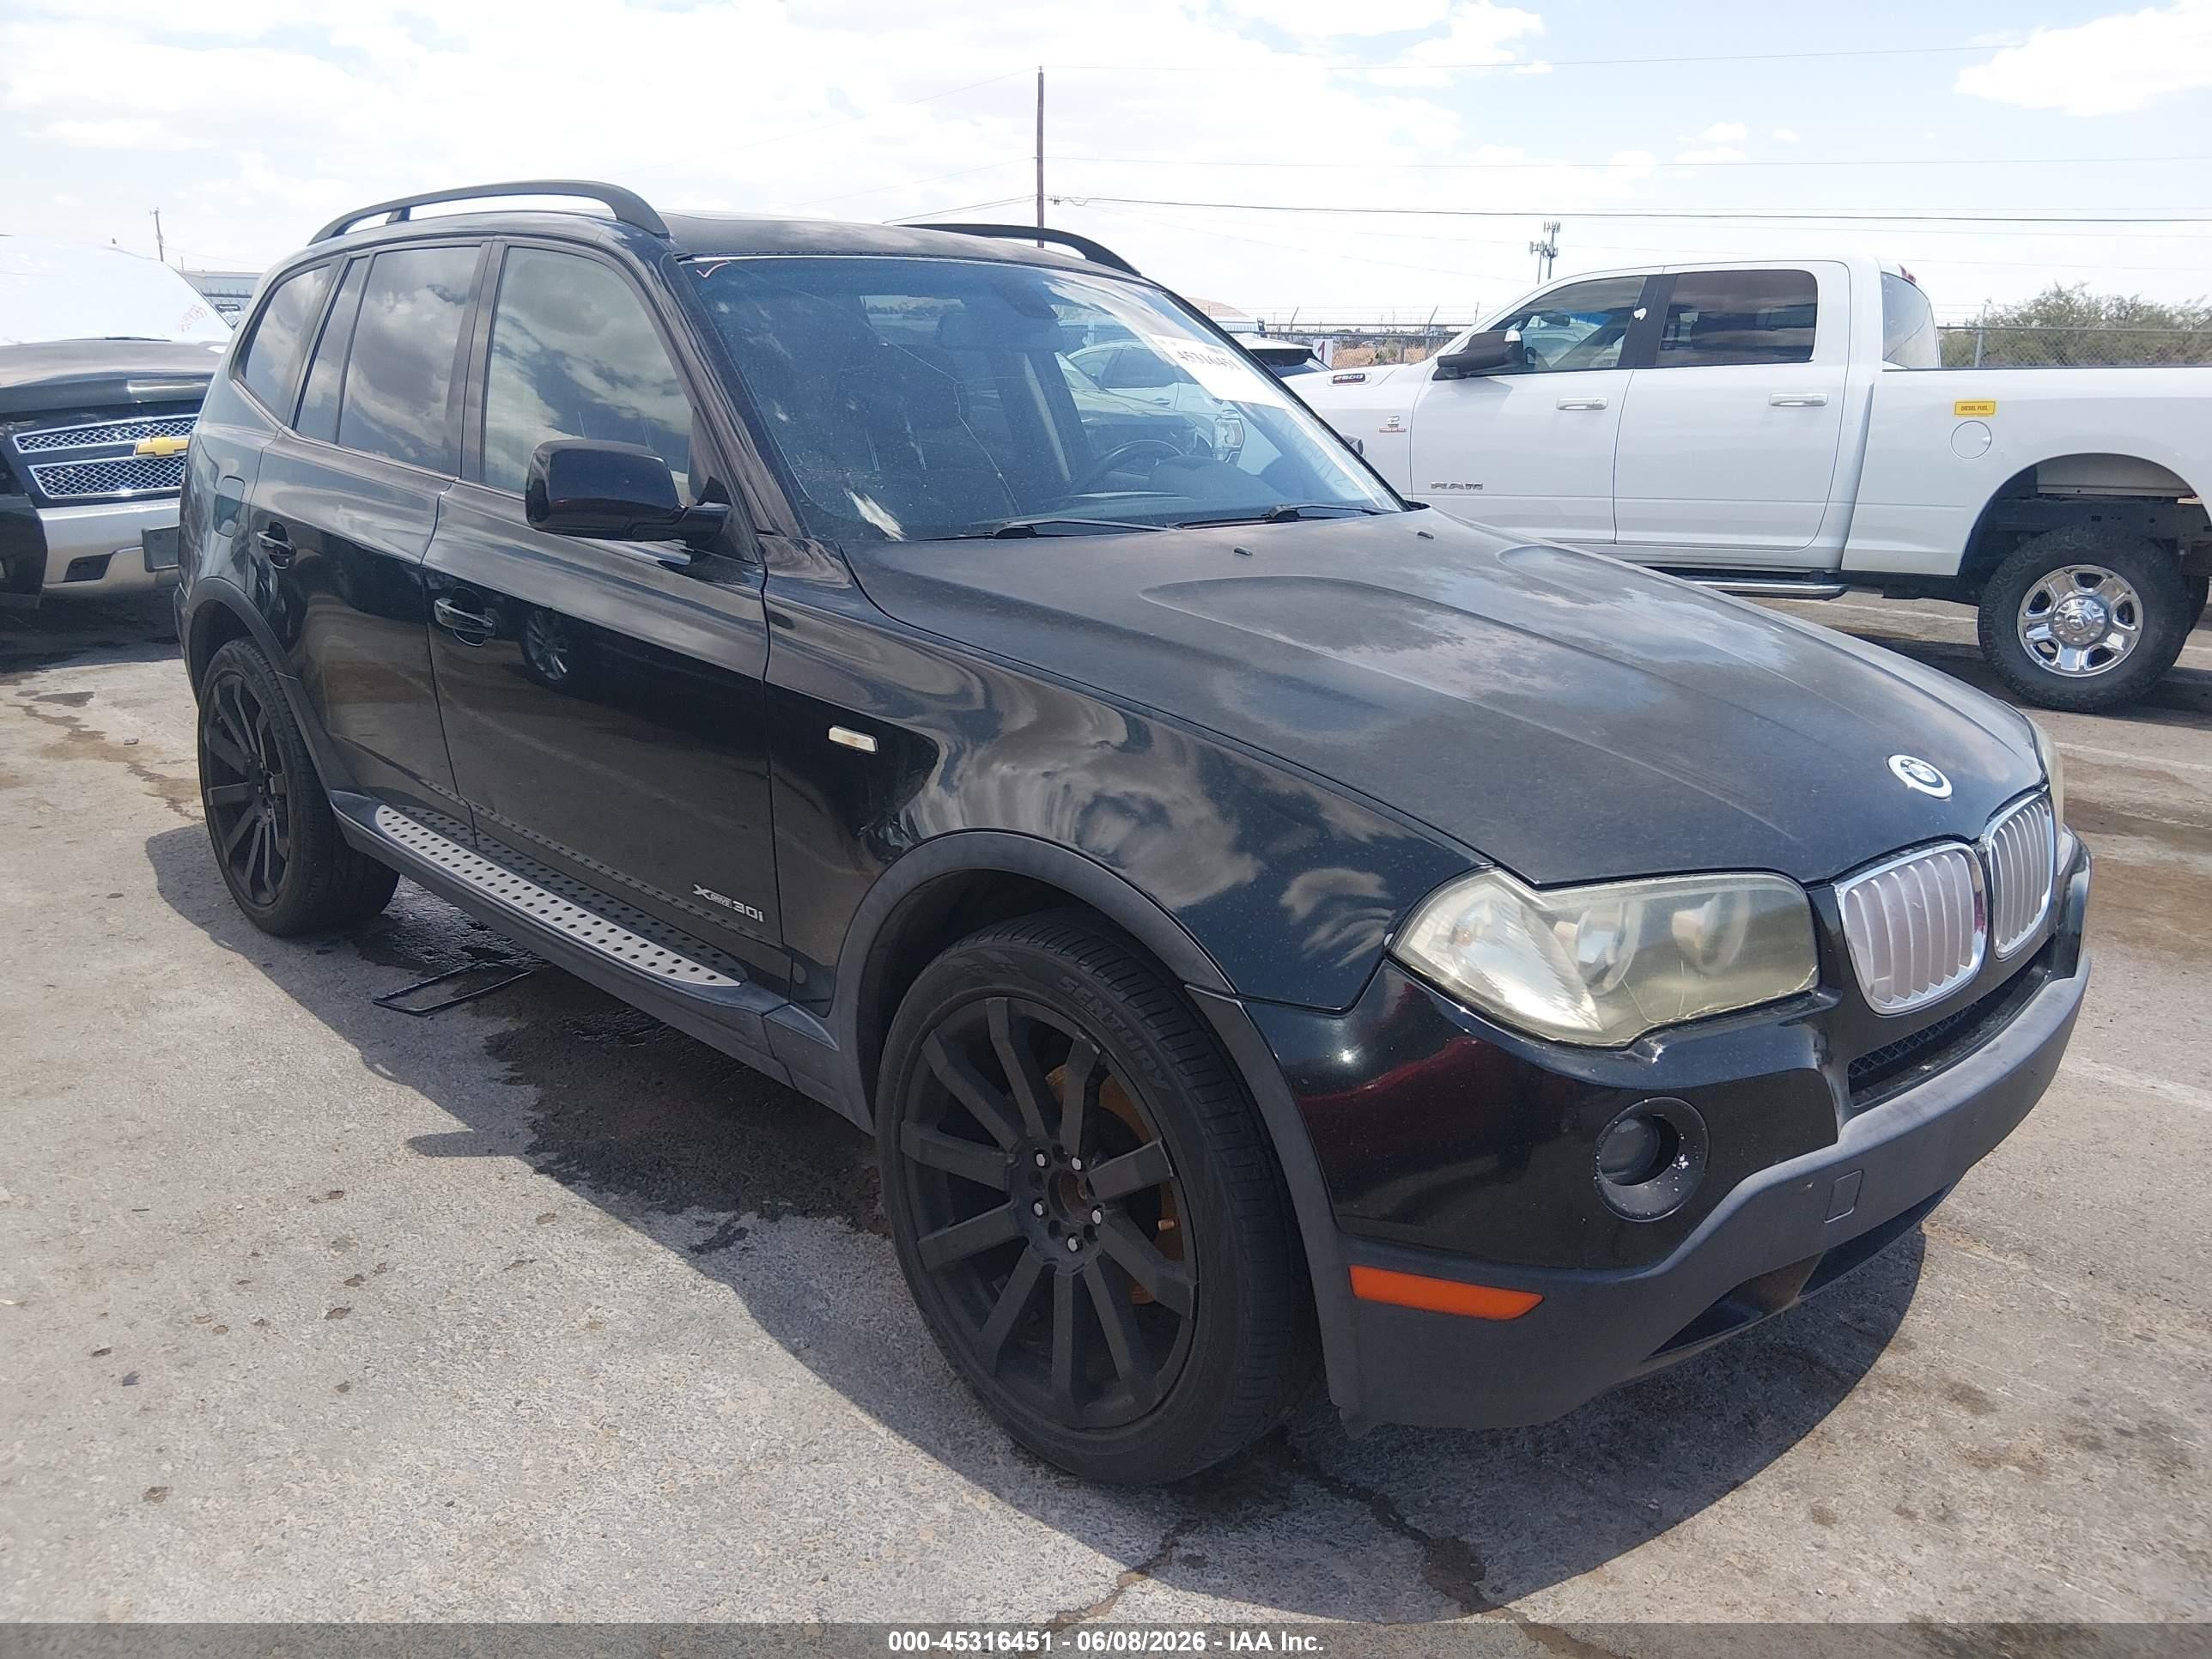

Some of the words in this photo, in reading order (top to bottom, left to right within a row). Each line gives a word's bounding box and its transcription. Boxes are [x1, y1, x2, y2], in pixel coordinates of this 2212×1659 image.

[1317, 341, 1326, 362] 1
[1430, 481, 1484, 490] RAM
[1057, 975, 1173, 1091] SENTURY
